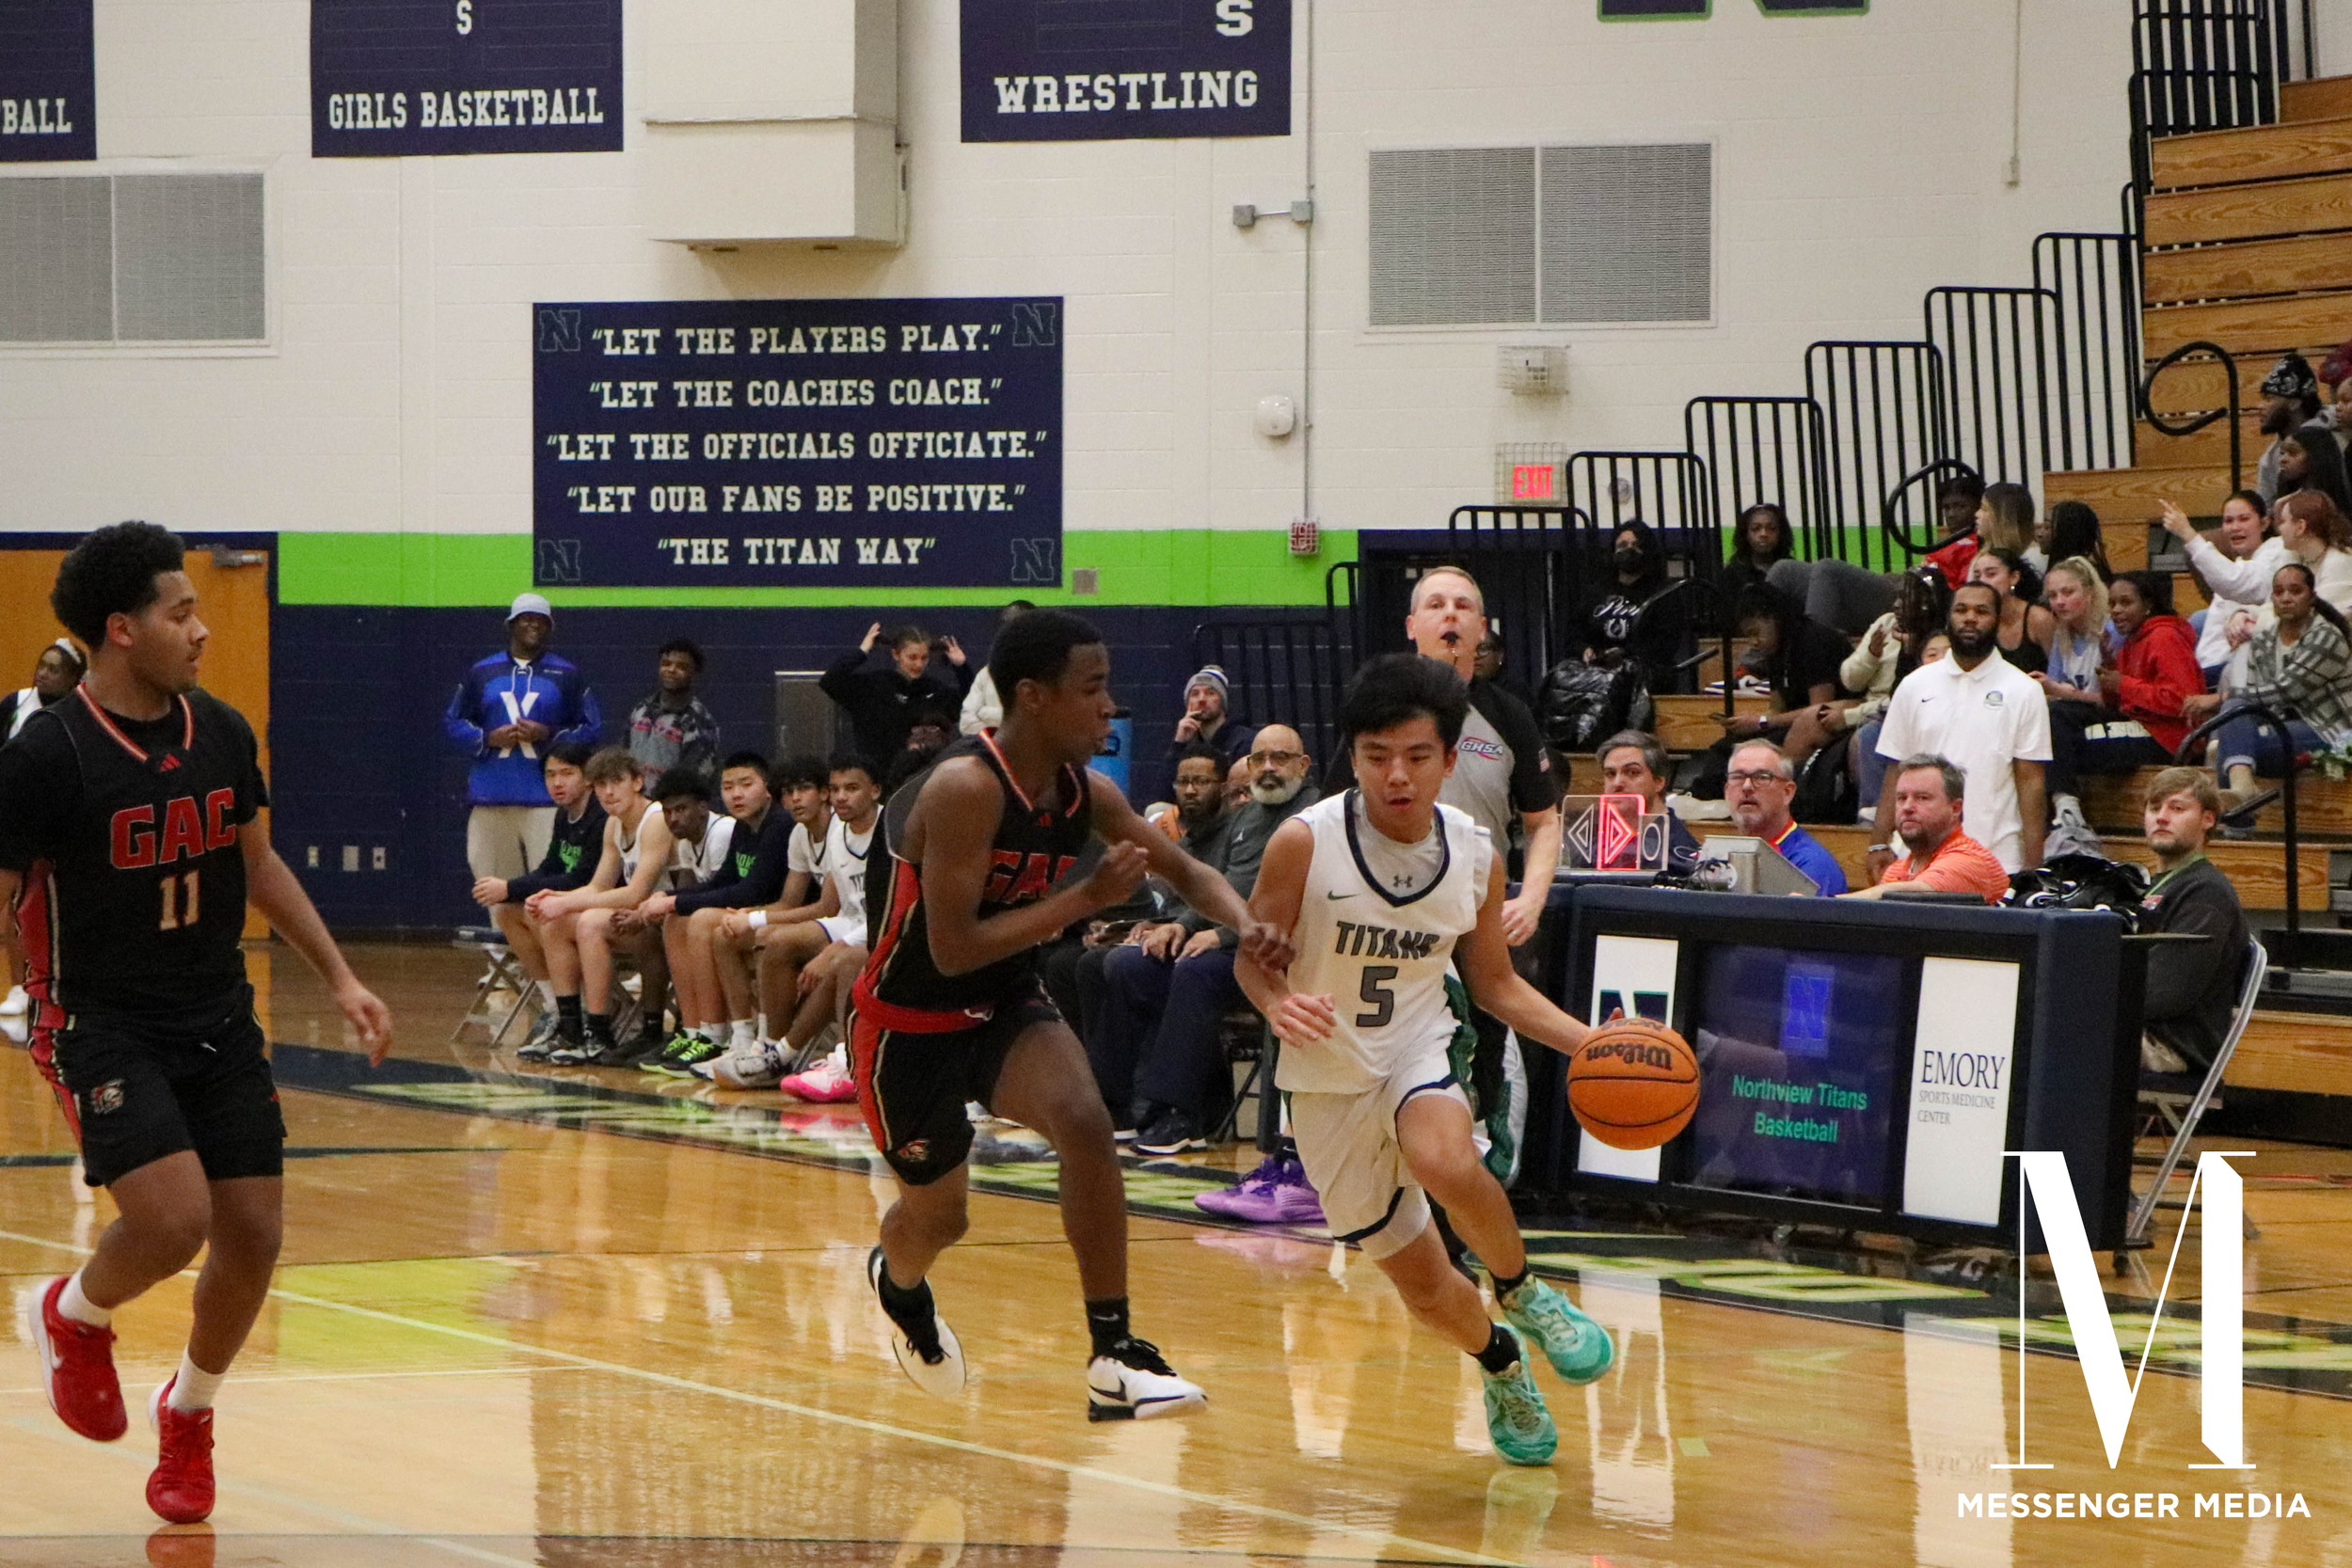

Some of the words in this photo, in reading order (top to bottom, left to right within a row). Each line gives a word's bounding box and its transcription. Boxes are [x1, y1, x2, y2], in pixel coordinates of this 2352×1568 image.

[328, 92, 407, 130] GIRLS
[420, 87, 604, 128] BASKETBALL
[993, 70, 1259, 114] WRESTLING
[2, 98, 72, 135] BALL
[539, 309, 580, 351] N
[675, 327, 735, 355] THE
[749, 325, 886, 355] PLAYERS
[901, 324, 1002, 352] PLAY.”
[1012, 304, 1056, 345] N
[673, 380, 733, 407] THE
[747, 379, 875, 407] COACHES
[889, 377, 1003, 405] COACH.”
[629, 433, 690, 461] THE
[703, 432, 855, 460] OFFICIALS
[650, 485, 708, 513] OUR
[722, 485, 802, 513] FANS
[816, 484, 853, 512] BE
[866, 483, 1025, 512] POSITIVE.”
[1513, 465, 1553, 498] EXIT
[539, 540, 580, 581] N
[743, 538, 841, 565] TITAN
[855, 537, 936, 565] WAY”
[1010, 539, 1055, 581] N
[1460, 740, 1504, 754] GHSA
[110, 787, 236, 870] GAC
[158, 869, 201, 931] 11
[1335, 920, 1440, 959] TITANS
[1356, 965, 1399, 1027] 5
[1586, 1042, 1673, 1071] Wilson
[1921, 1050, 2006, 1089] EMORY
[1732, 1074, 1815, 1105] Northview
[1818, 1083, 1867, 1111] Titans
[1919, 1090, 1950, 1105] SPORTS
[1951, 1093, 1995, 1109] MEDICINE
[1754, 1111, 1838, 1144] Basketball
[1917, 1110, 1950, 1125] CENTER
